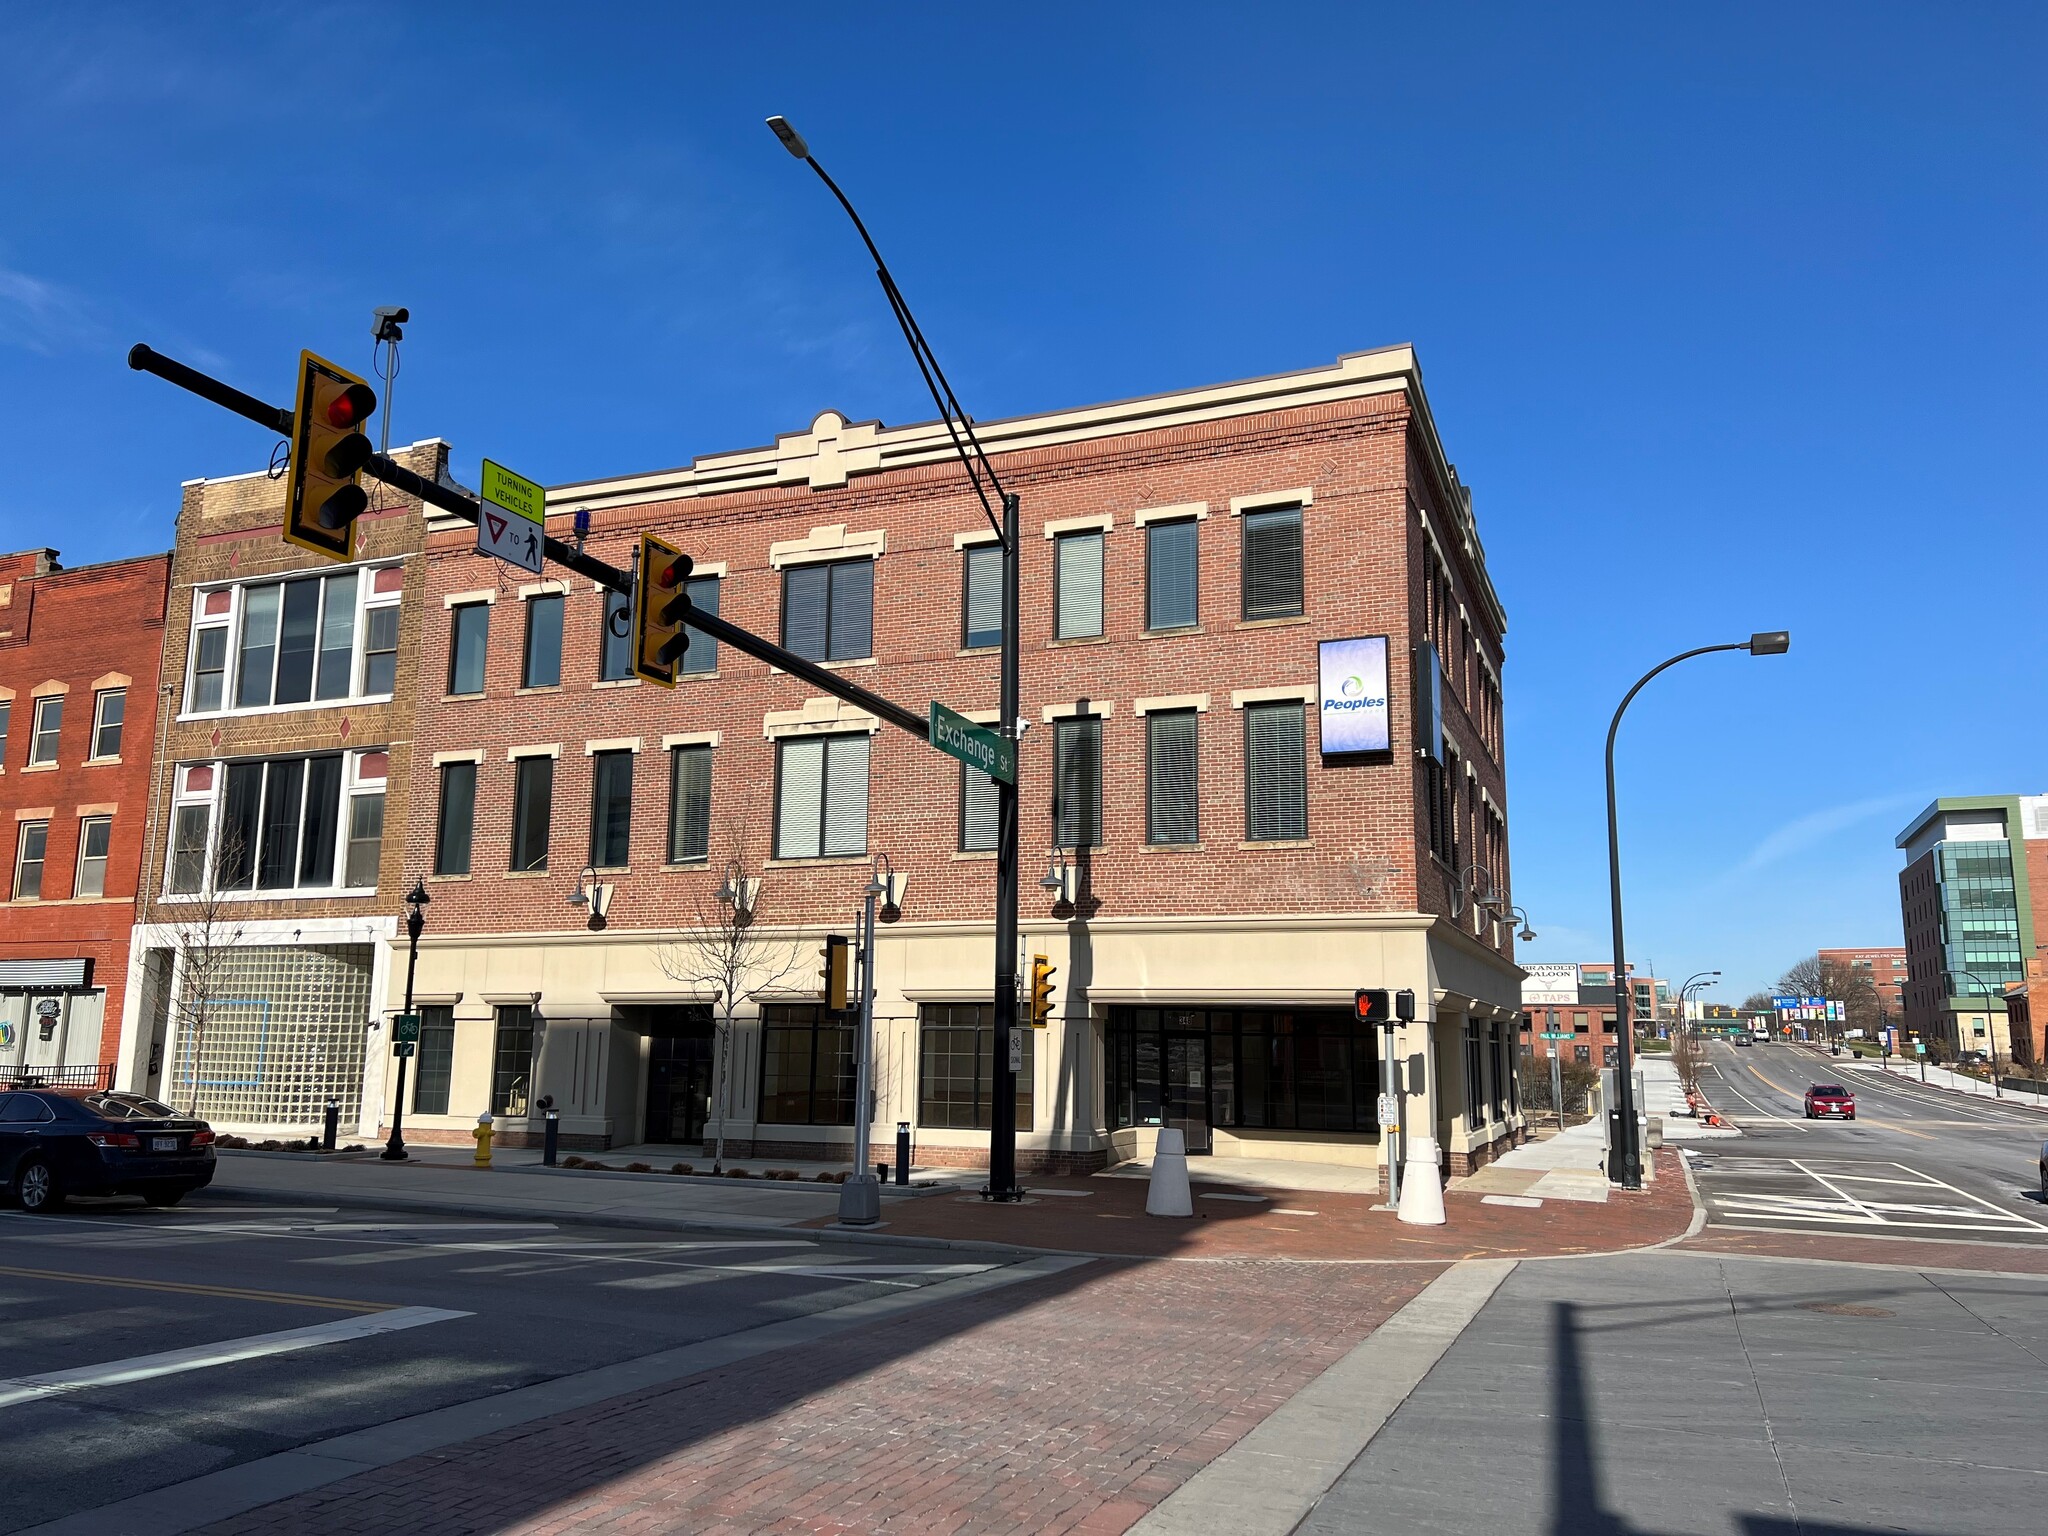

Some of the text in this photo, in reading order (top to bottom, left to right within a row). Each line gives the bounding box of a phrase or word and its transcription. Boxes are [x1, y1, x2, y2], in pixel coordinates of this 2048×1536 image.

[497, 472, 532, 498] TURNING
[495, 488, 532, 514] VEHICLES
[509, 532, 520, 545] TO
[1323, 697, 1385, 710] Peoples
[937, 715, 1008, 773] Exchange St
[1542, 993, 1571, 1002] TAPS
